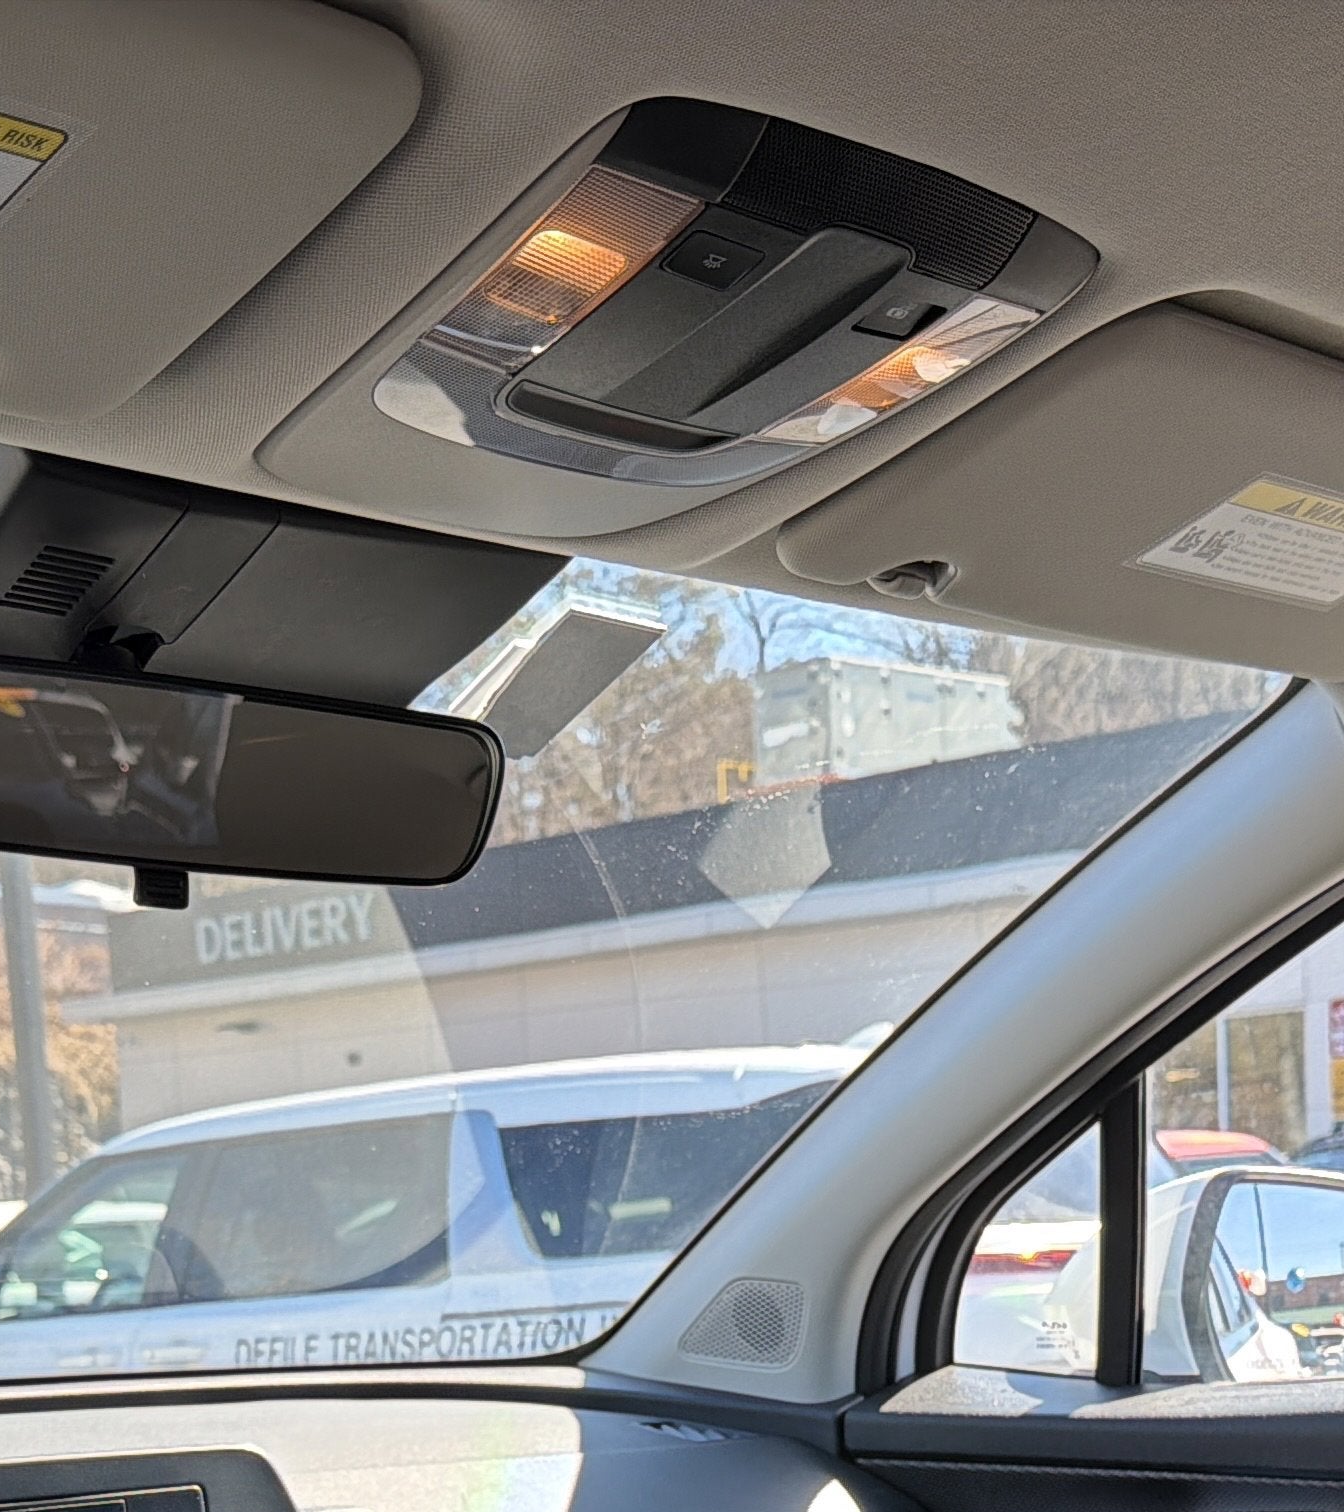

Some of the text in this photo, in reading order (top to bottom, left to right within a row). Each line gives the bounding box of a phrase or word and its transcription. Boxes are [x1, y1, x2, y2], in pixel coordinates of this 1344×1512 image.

[0, 128, 51, 152] RISK
[195, 891, 374, 964] DELIVERY
[330, 1313, 586, 1363] TRANSPORTATION
